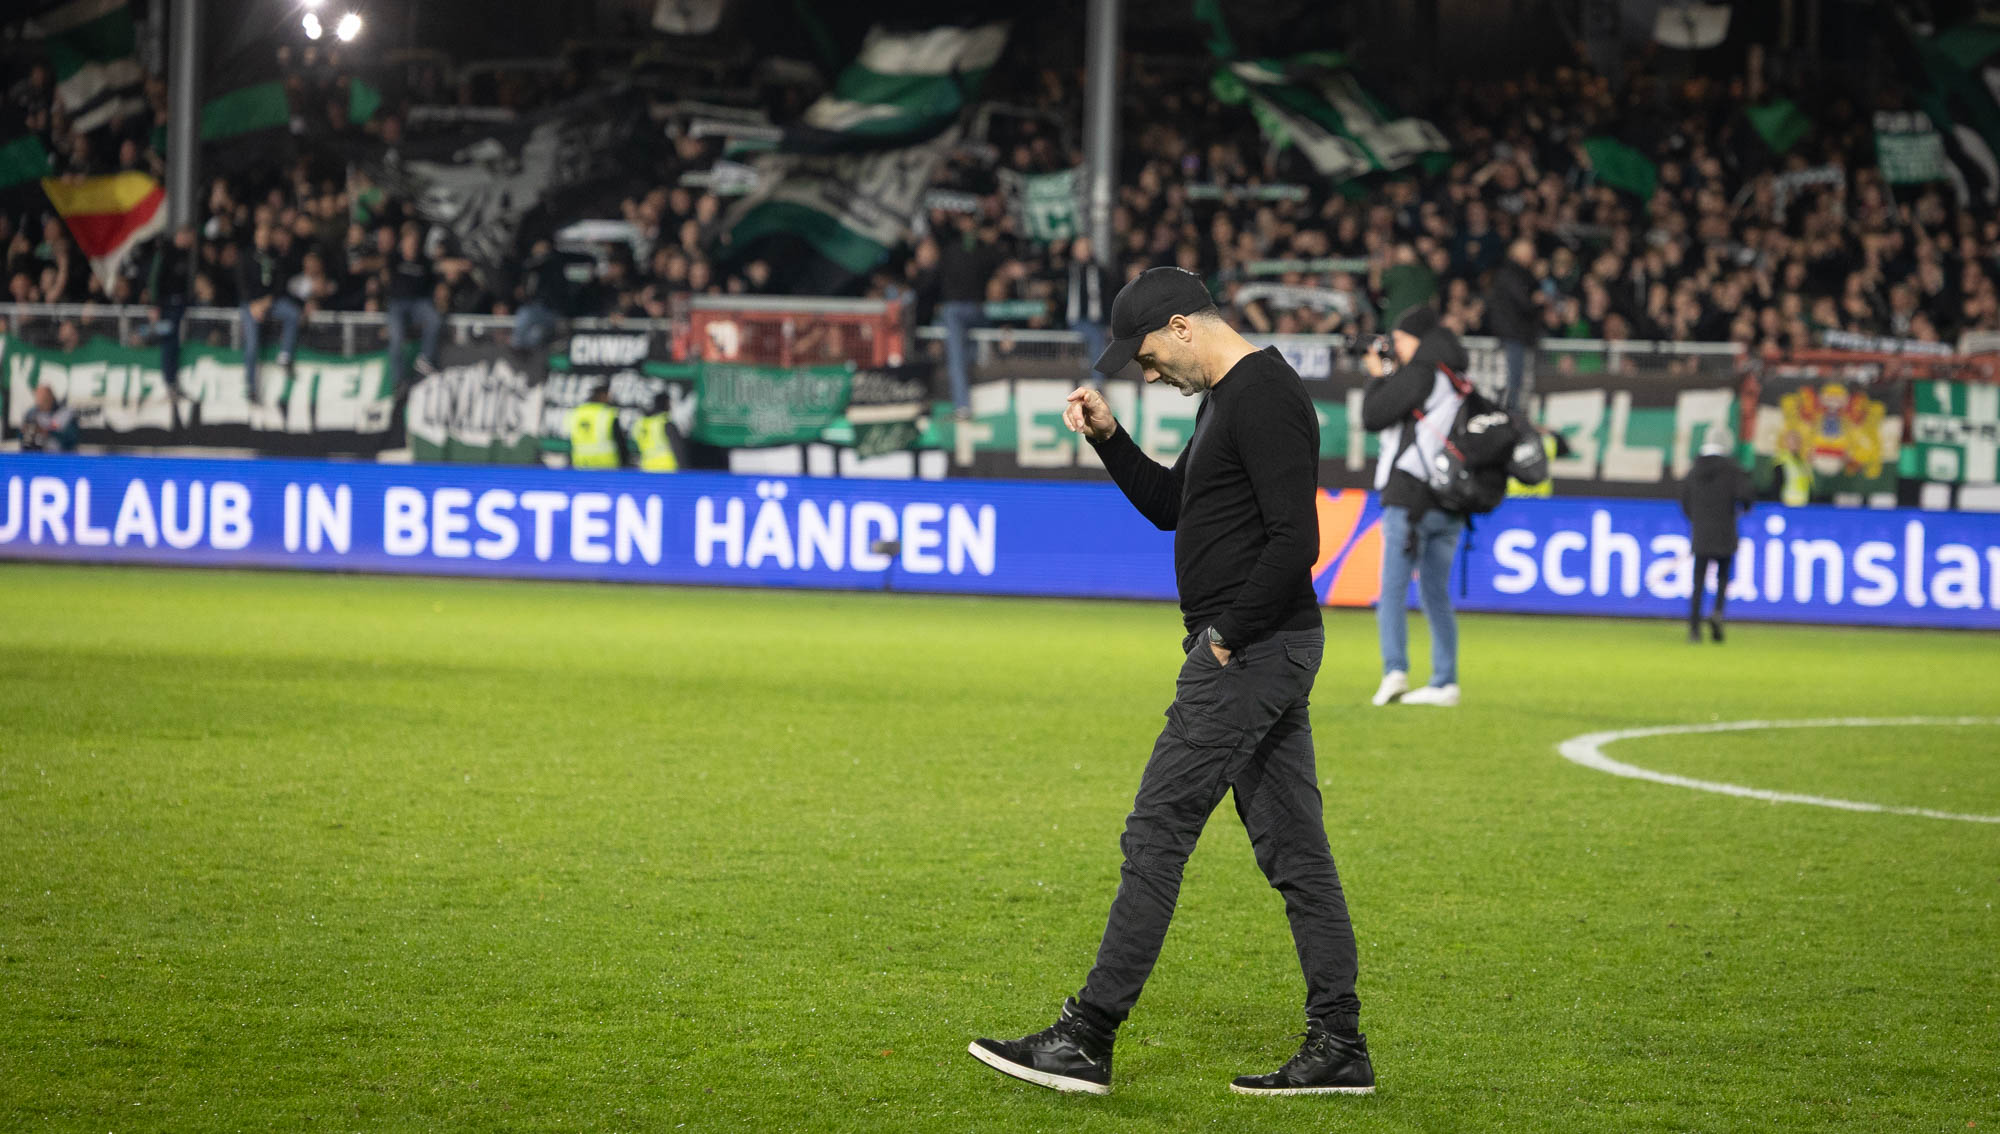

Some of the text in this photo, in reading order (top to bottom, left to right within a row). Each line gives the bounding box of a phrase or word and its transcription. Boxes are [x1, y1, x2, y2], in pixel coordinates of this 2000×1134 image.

[284, 482, 351, 555] IN
[384, 486, 663, 566] BESTEN
[696, 480, 996, 576] HÄNDEN
[1493, 509, 2000, 609] schauinsla
